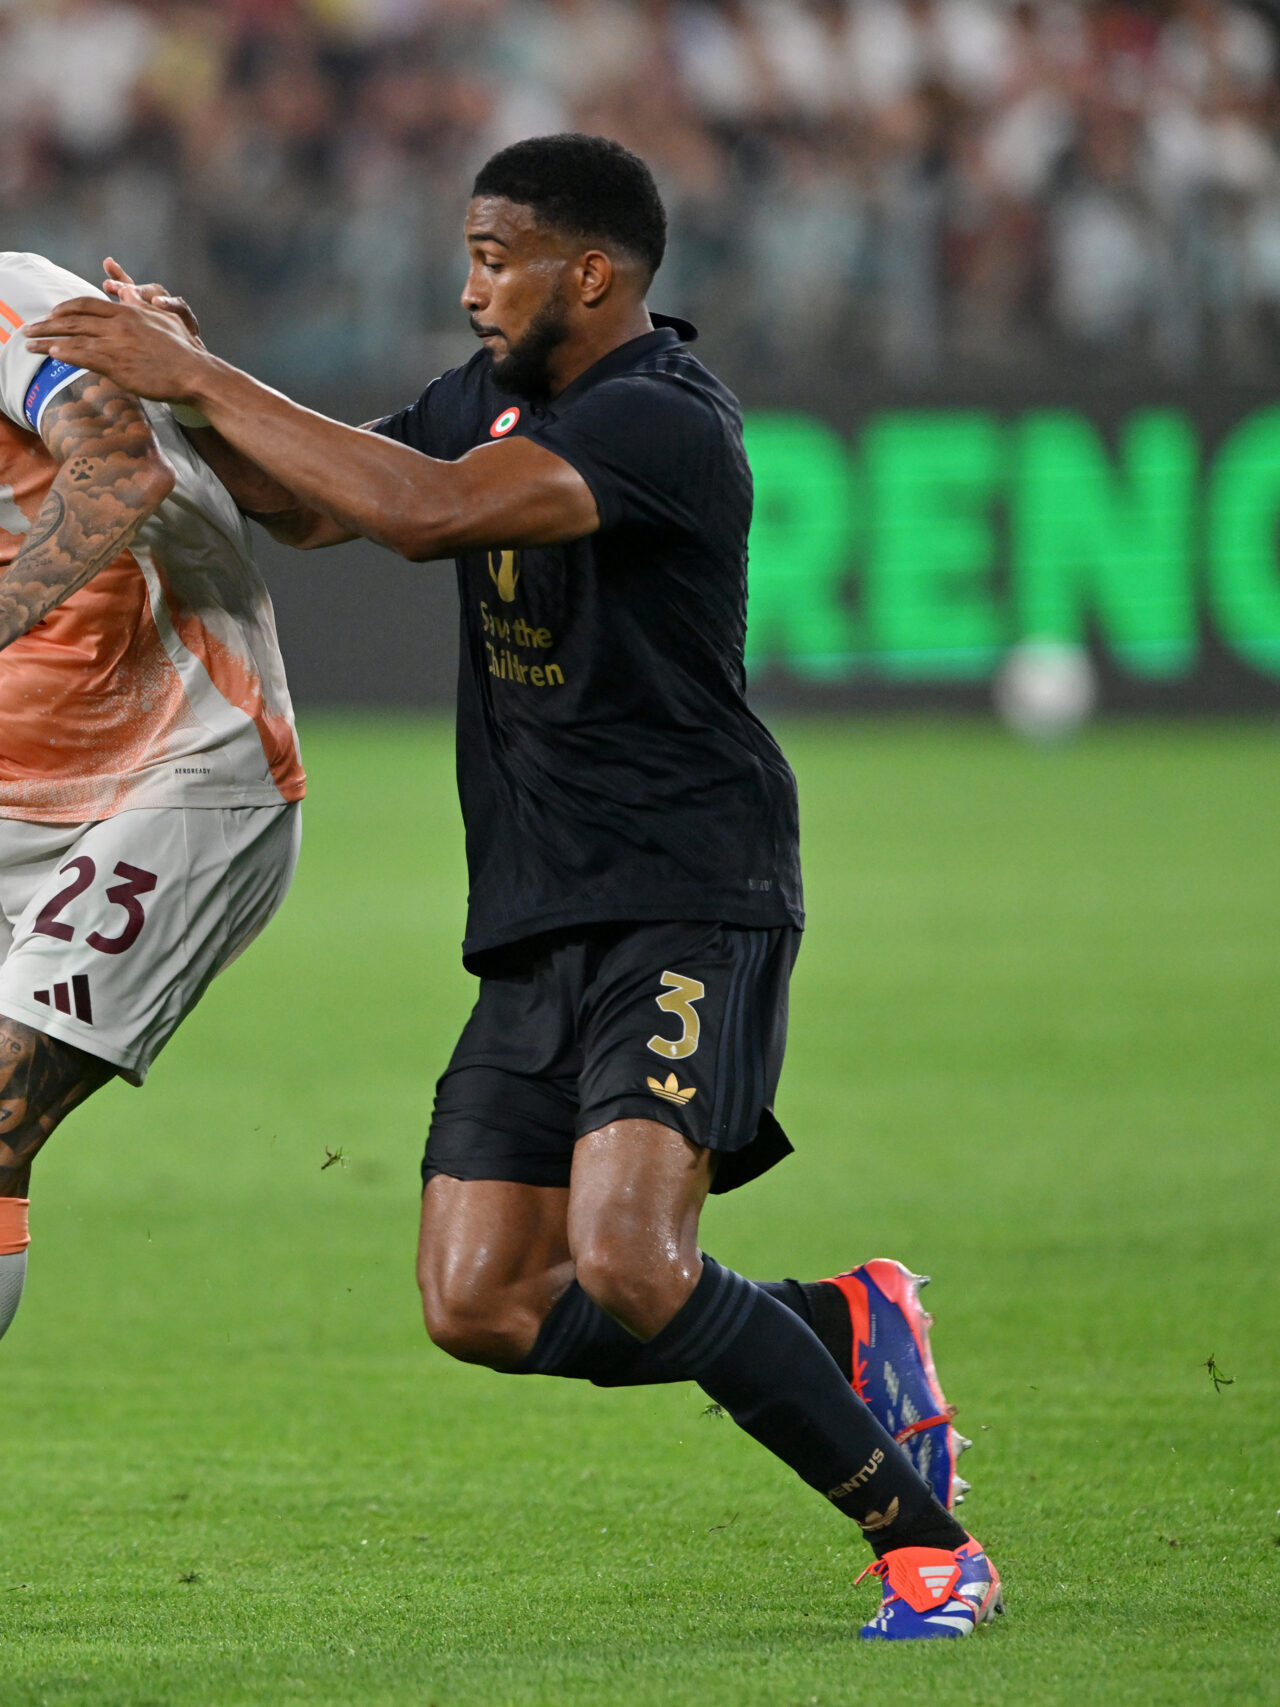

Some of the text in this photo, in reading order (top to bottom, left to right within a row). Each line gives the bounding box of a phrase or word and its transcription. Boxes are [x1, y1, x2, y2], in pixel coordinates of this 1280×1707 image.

[25, 383, 41, 409] OUT
[513, 617, 554, 649] the
[31, 855, 158, 955] 23
[646, 970, 705, 1060] 3
